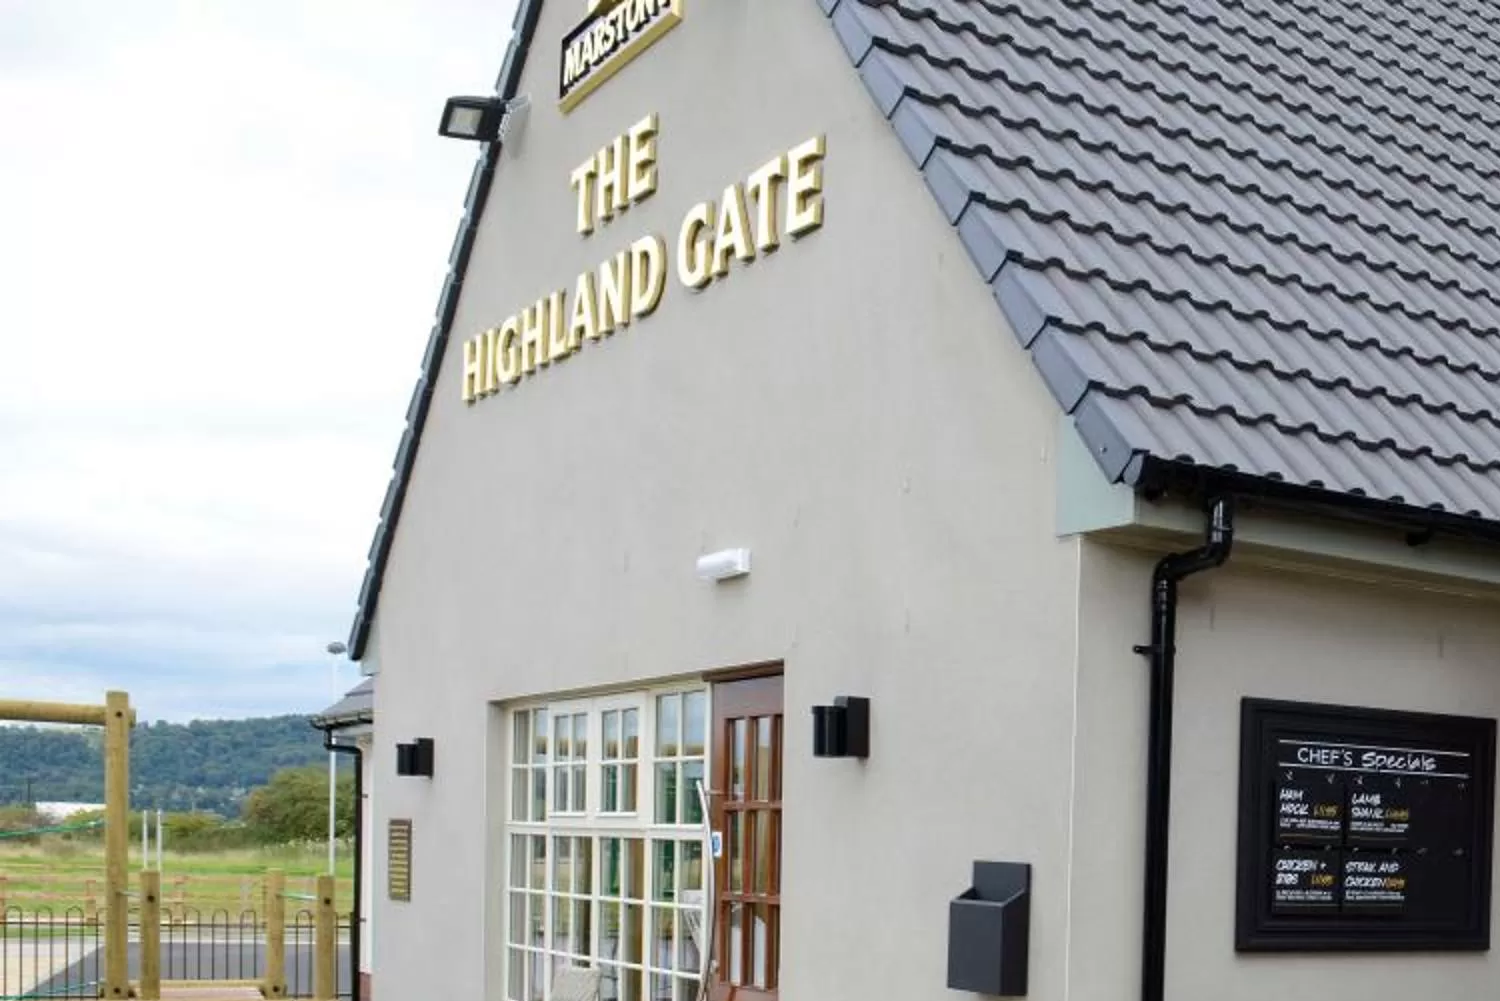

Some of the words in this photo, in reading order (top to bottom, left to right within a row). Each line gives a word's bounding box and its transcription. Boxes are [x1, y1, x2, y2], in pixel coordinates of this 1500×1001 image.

[563, 0, 667, 87] MARSTON
[571, 112, 659, 235] THE
[462, 235, 668, 402] HIGHLAND
[677, 134, 826, 290] GATE
[1297, 747, 1353, 767] CHEF'S
